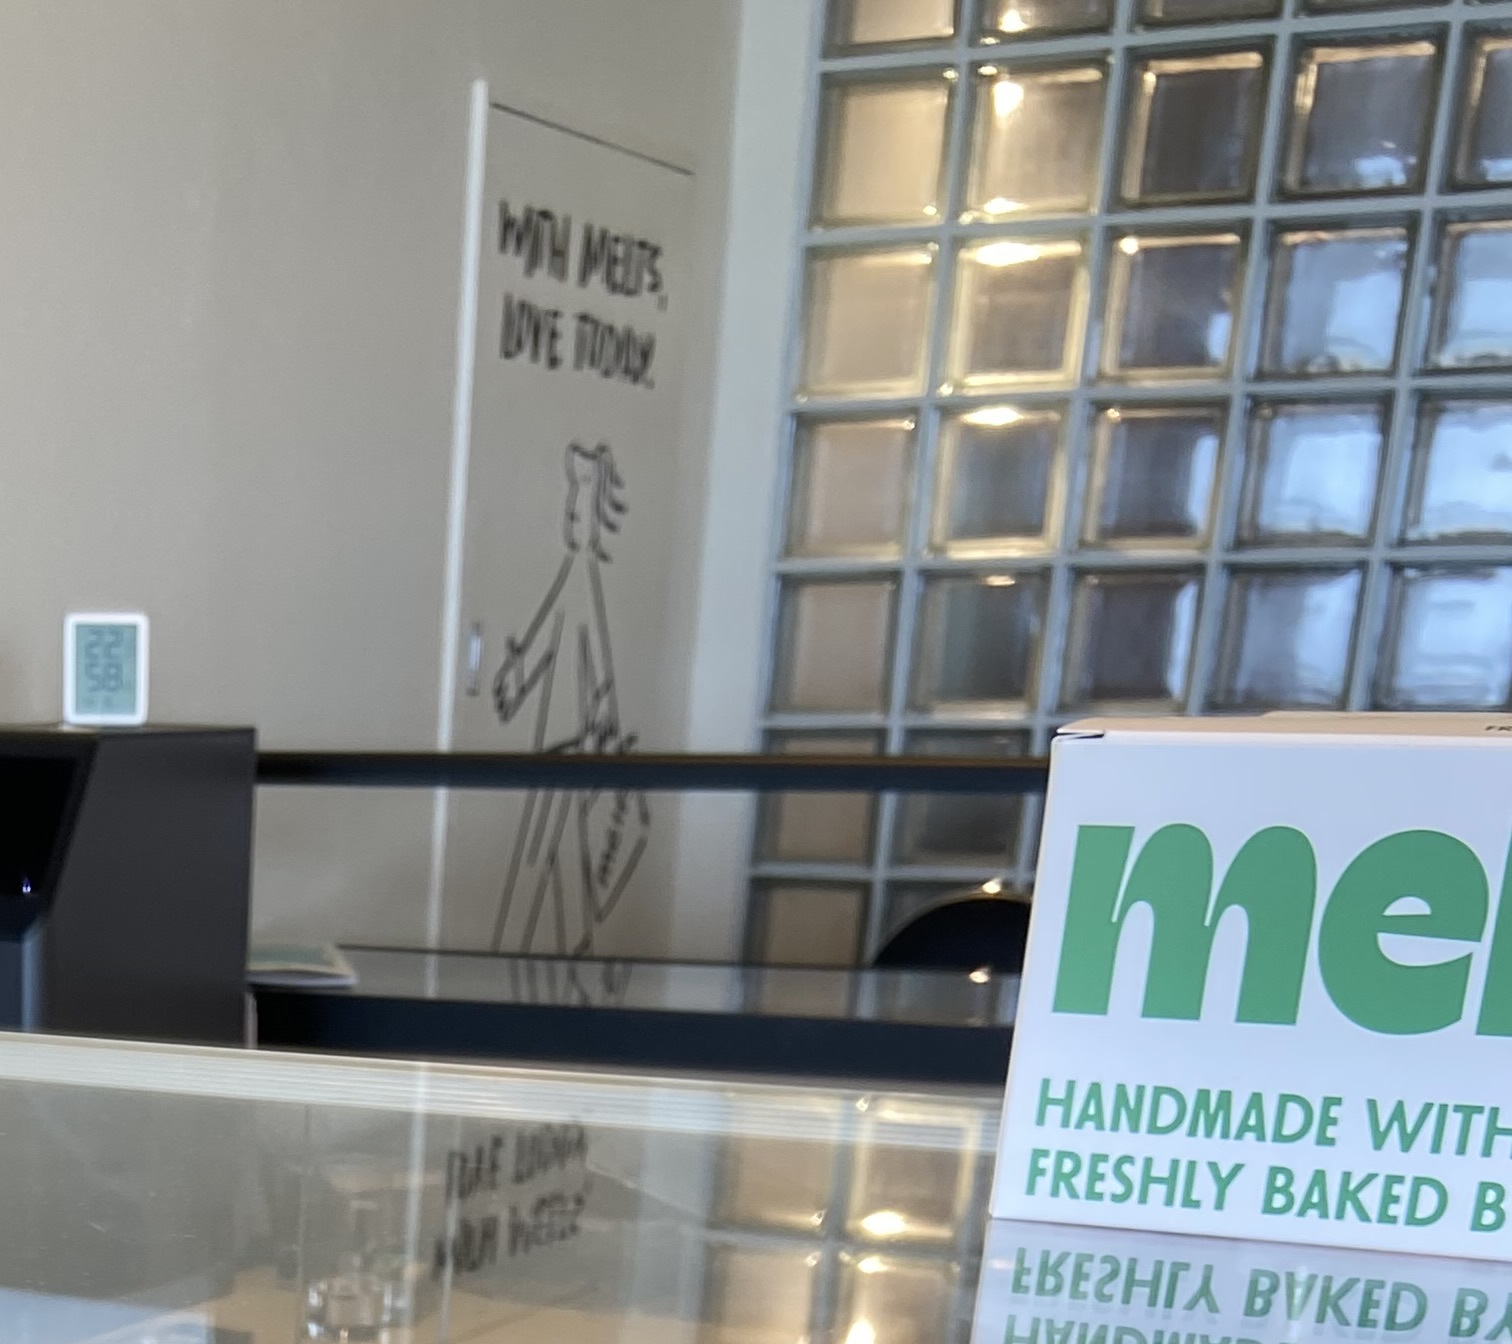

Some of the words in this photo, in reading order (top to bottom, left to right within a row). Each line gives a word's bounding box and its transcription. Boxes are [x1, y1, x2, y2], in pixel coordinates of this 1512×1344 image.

[1035, 1078, 1342, 1147] HANDMADE
[1025, 1149, 1244, 1212] FRESHLY
[1262, 1166, 1448, 1228] BAKED
